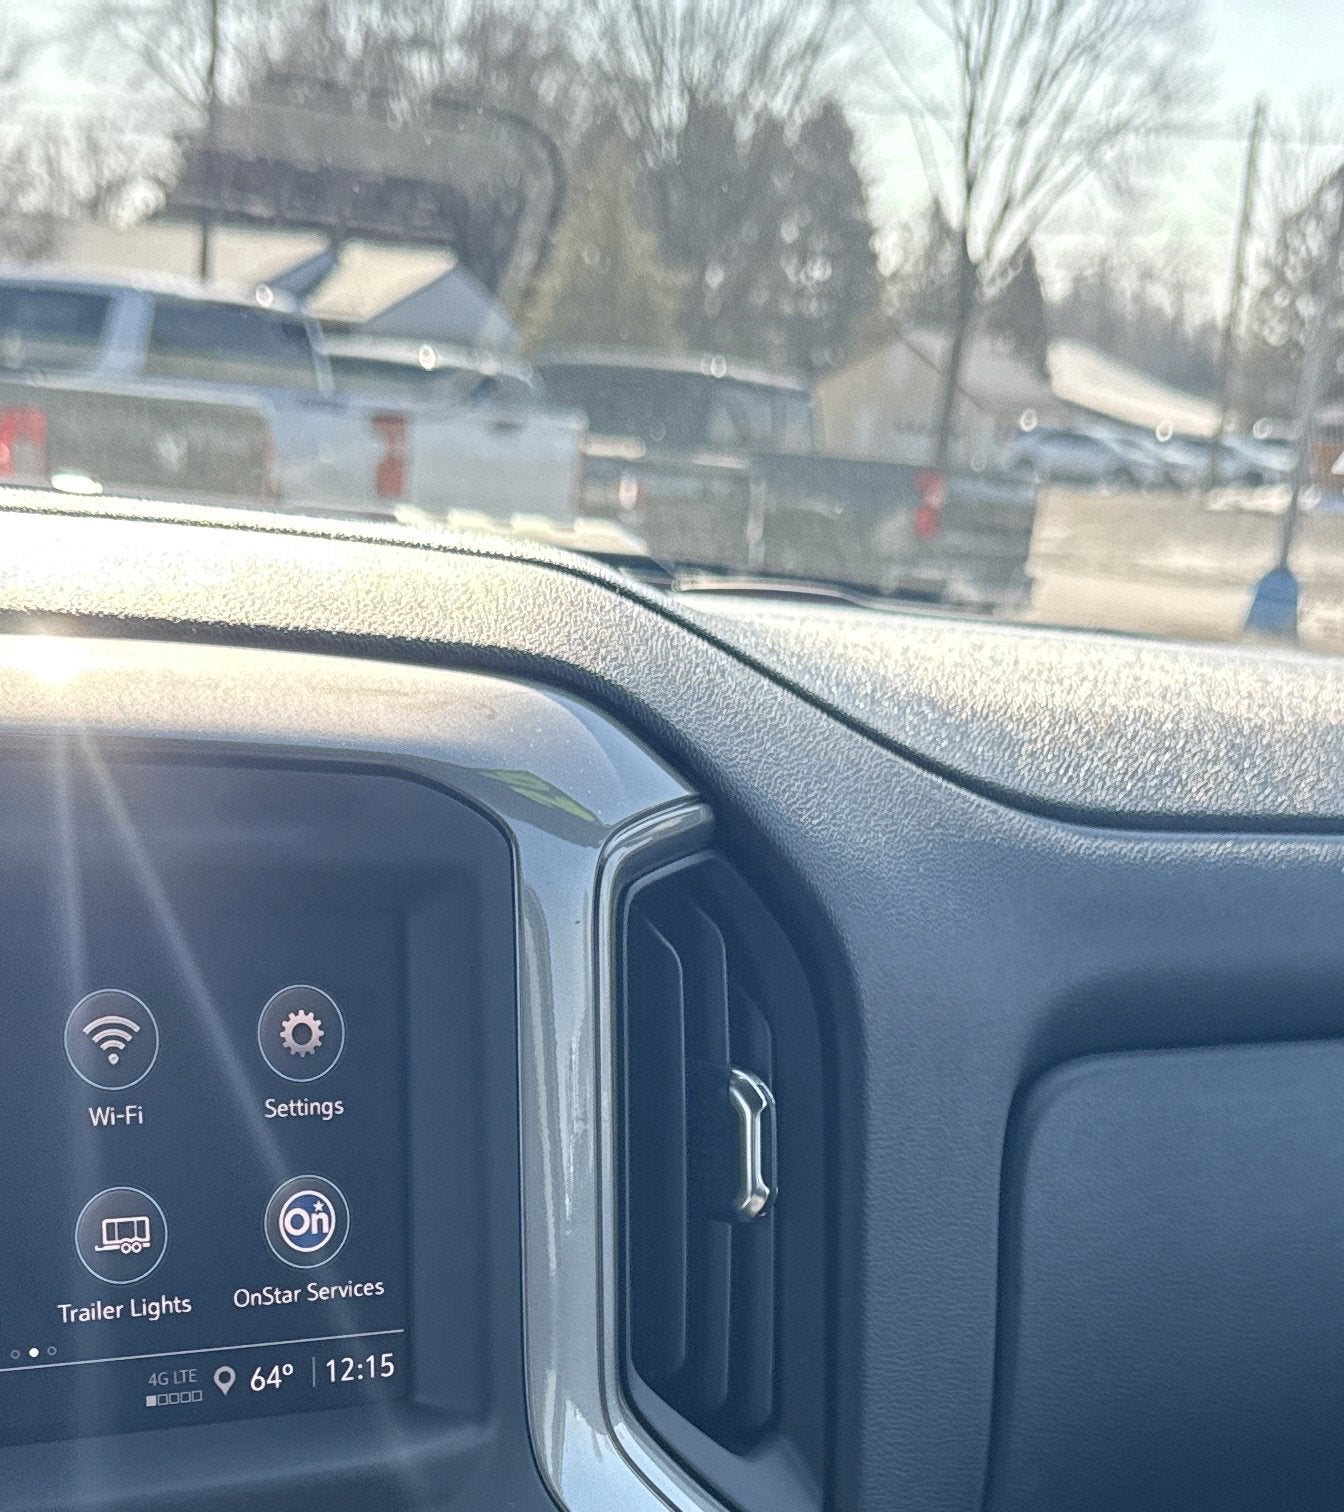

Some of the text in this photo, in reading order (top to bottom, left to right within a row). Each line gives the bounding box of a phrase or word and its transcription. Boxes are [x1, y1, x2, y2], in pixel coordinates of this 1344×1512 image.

[88, 1105, 144, 1126] Wi-Fi
[264, 1097, 344, 1121] Settings
[233, 1280, 385, 1308] OnStar Services
[57, 1294, 192, 1323] Trailer Lights
[148, 1368, 198, 1386] 4G LTE
[326, 1352, 395, 1383] 12:15
